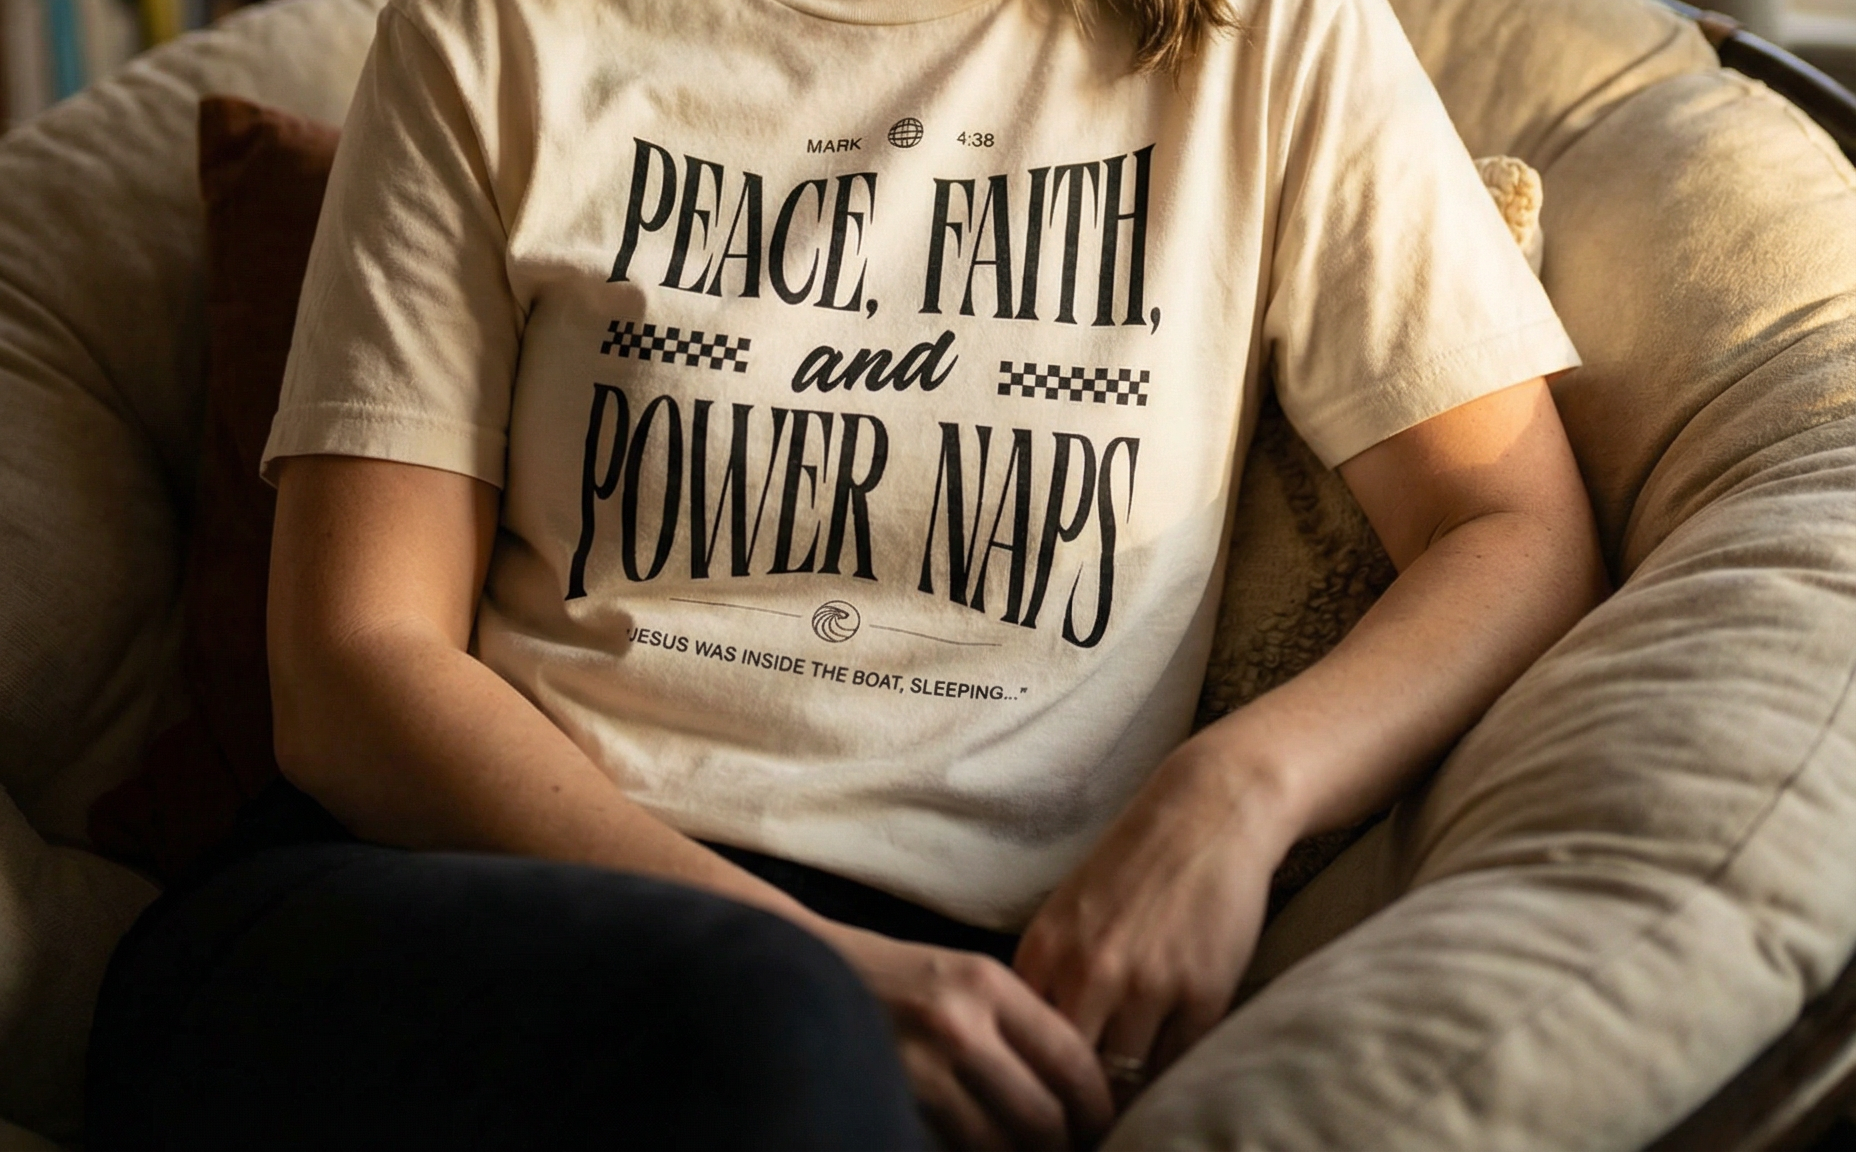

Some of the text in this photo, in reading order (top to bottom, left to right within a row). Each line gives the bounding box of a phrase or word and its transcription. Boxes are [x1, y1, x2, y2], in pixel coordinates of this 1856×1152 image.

[806, 131, 995, 154] MARK 4:38
[606, 136, 1161, 335] PEACE, FAITH,
[791, 329, 958, 393] and
[565, 382, 1141, 649] POWER NAPS
[695, 639, 737, 663] WAS
[741, 649, 806, 675] INSIDE
[811, 661, 849, 684] THE
[852, 669, 903, 694] BOAT,
